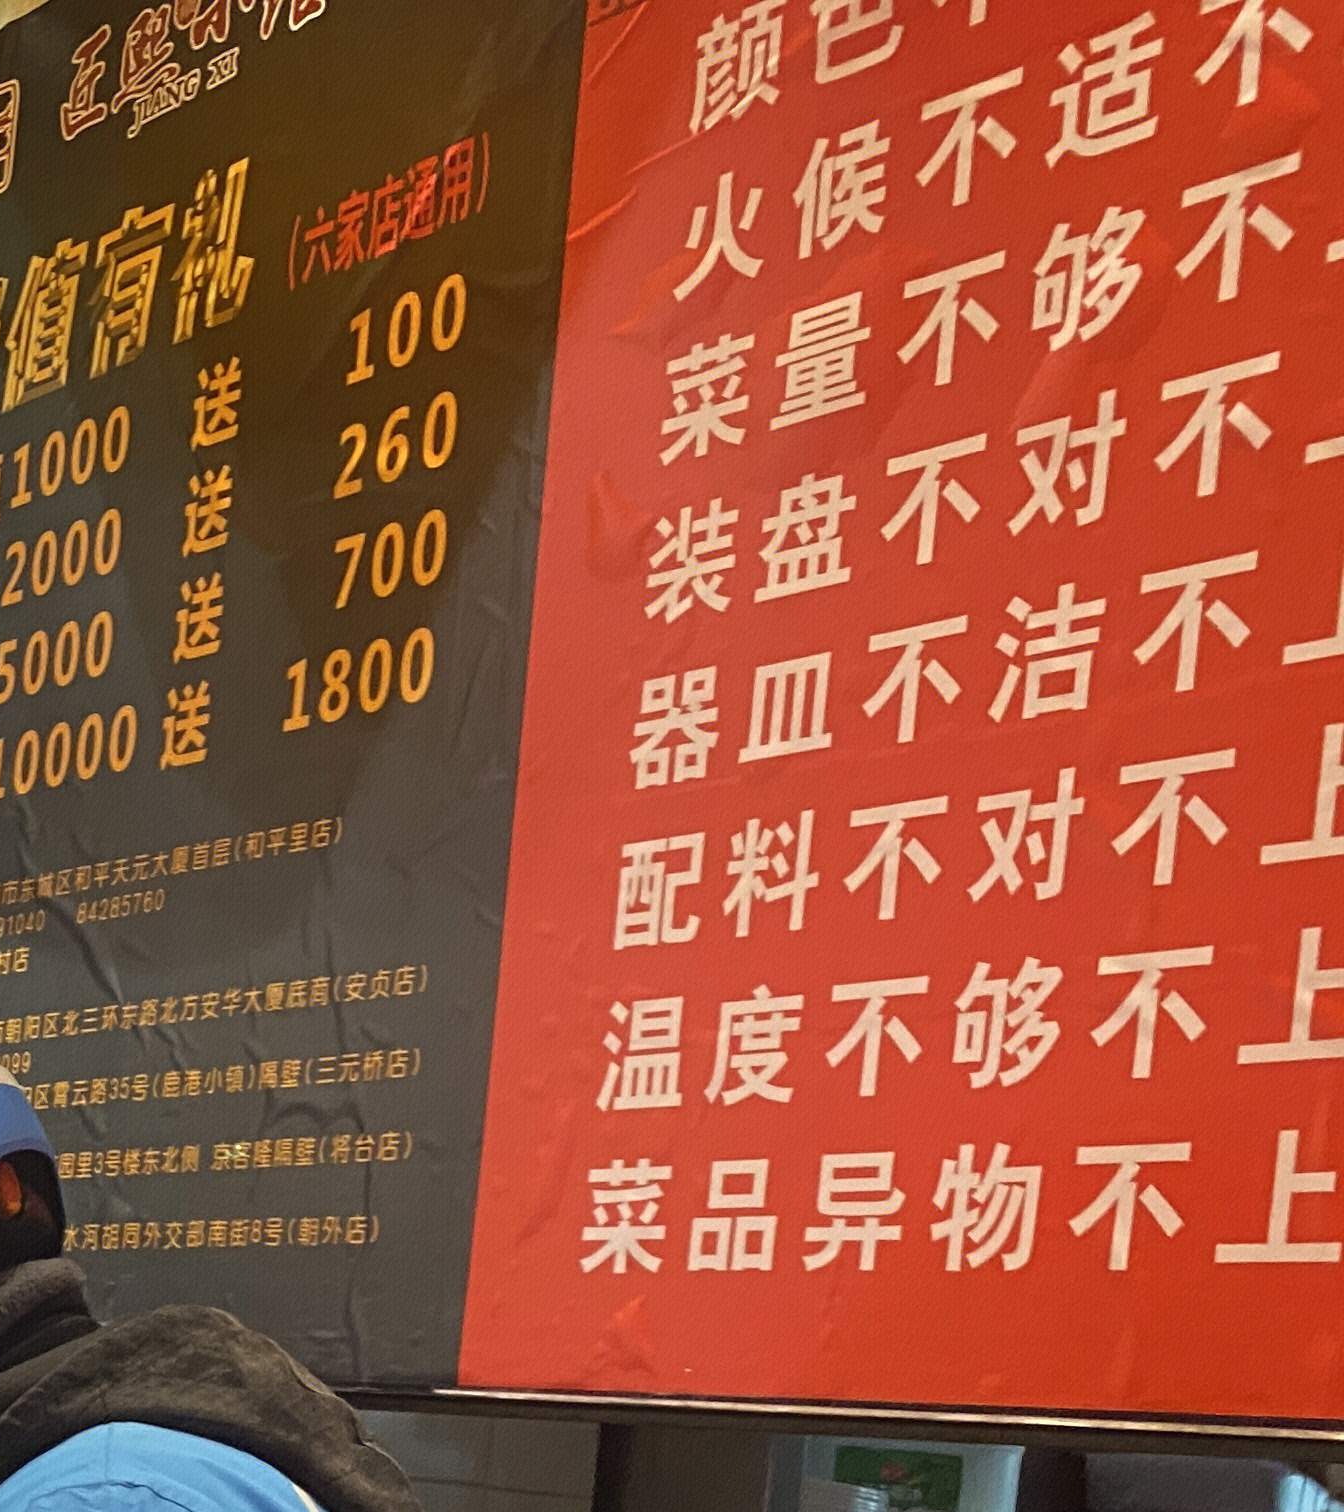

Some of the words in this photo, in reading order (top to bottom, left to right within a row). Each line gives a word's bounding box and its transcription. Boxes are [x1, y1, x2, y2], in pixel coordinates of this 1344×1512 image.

[127, 68, 202, 139] JIANG
[688, 0, 992, 132] 颜色
[189, 356, 243, 452] 送
[345, 274, 468, 387] 100
[659, 150, 1344, 467] 菜量不够不
[181, 465, 234, 558] 送
[333, 390, 459, 500] 260
[172, 572, 225, 664] 送
[333, 508, 449, 611] 700
[159, 680, 212, 770] 送
[281, 626, 438, 734] 1800
[612, 722, 1344, 950] 配料不对不上
[596, 926, 1344, 1112] 温度不够不上
[579, 1128, 1342, 1275] 菜品异物不上
